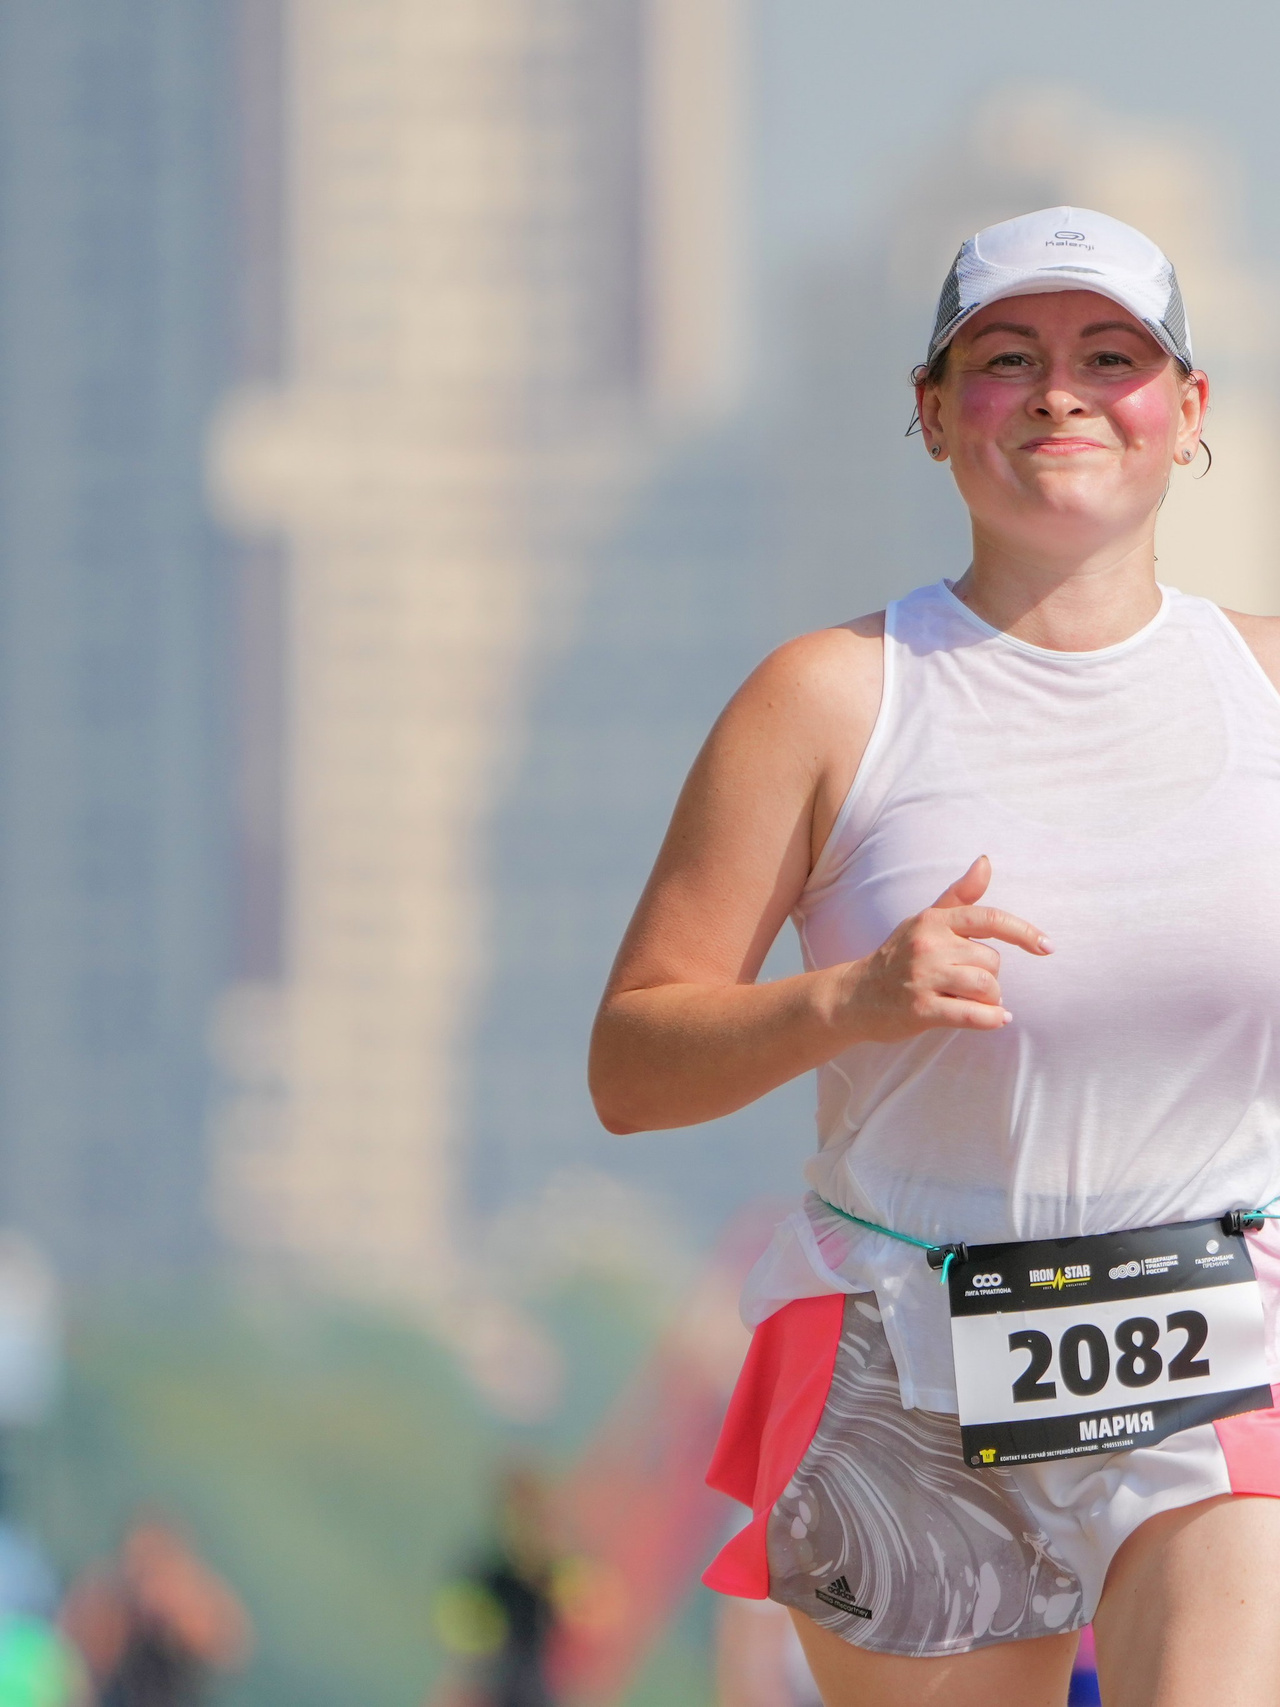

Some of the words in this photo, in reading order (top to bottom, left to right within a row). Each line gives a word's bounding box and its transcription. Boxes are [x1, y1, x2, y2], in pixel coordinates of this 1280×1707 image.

[1045, 240, 1095, 251] Kalenji
[1145, 1260, 1179, 1270] ТРИАТЛОНА
[1194, 1253, 1235, 1265] ГАЗПРОМБАНК
[1202, 1260, 1230, 1269] ПРЕМИУМ
[1029, 1268, 1055, 1283] IRON
[1064, 1264, 1091, 1279] STAR
[1146, 1267, 1169, 1275] РОССИИ
[979, 1287, 1012, 1296] ТРИАТЛОНА
[1008, 1310, 1210, 1403] 2082
[1079, 1411, 1155, 1442] МАРИЯ
[1000, 1454, 1021, 1462] КОНТАКТ
[1028, 1451, 1047, 1459] СЛУЧАЙ
[1046, 1447, 1074, 1457] ЭКСТРЕННОЙ
[828, 1586, 856, 1602] adidas
[833, 1599, 869, 1618] mccartney
